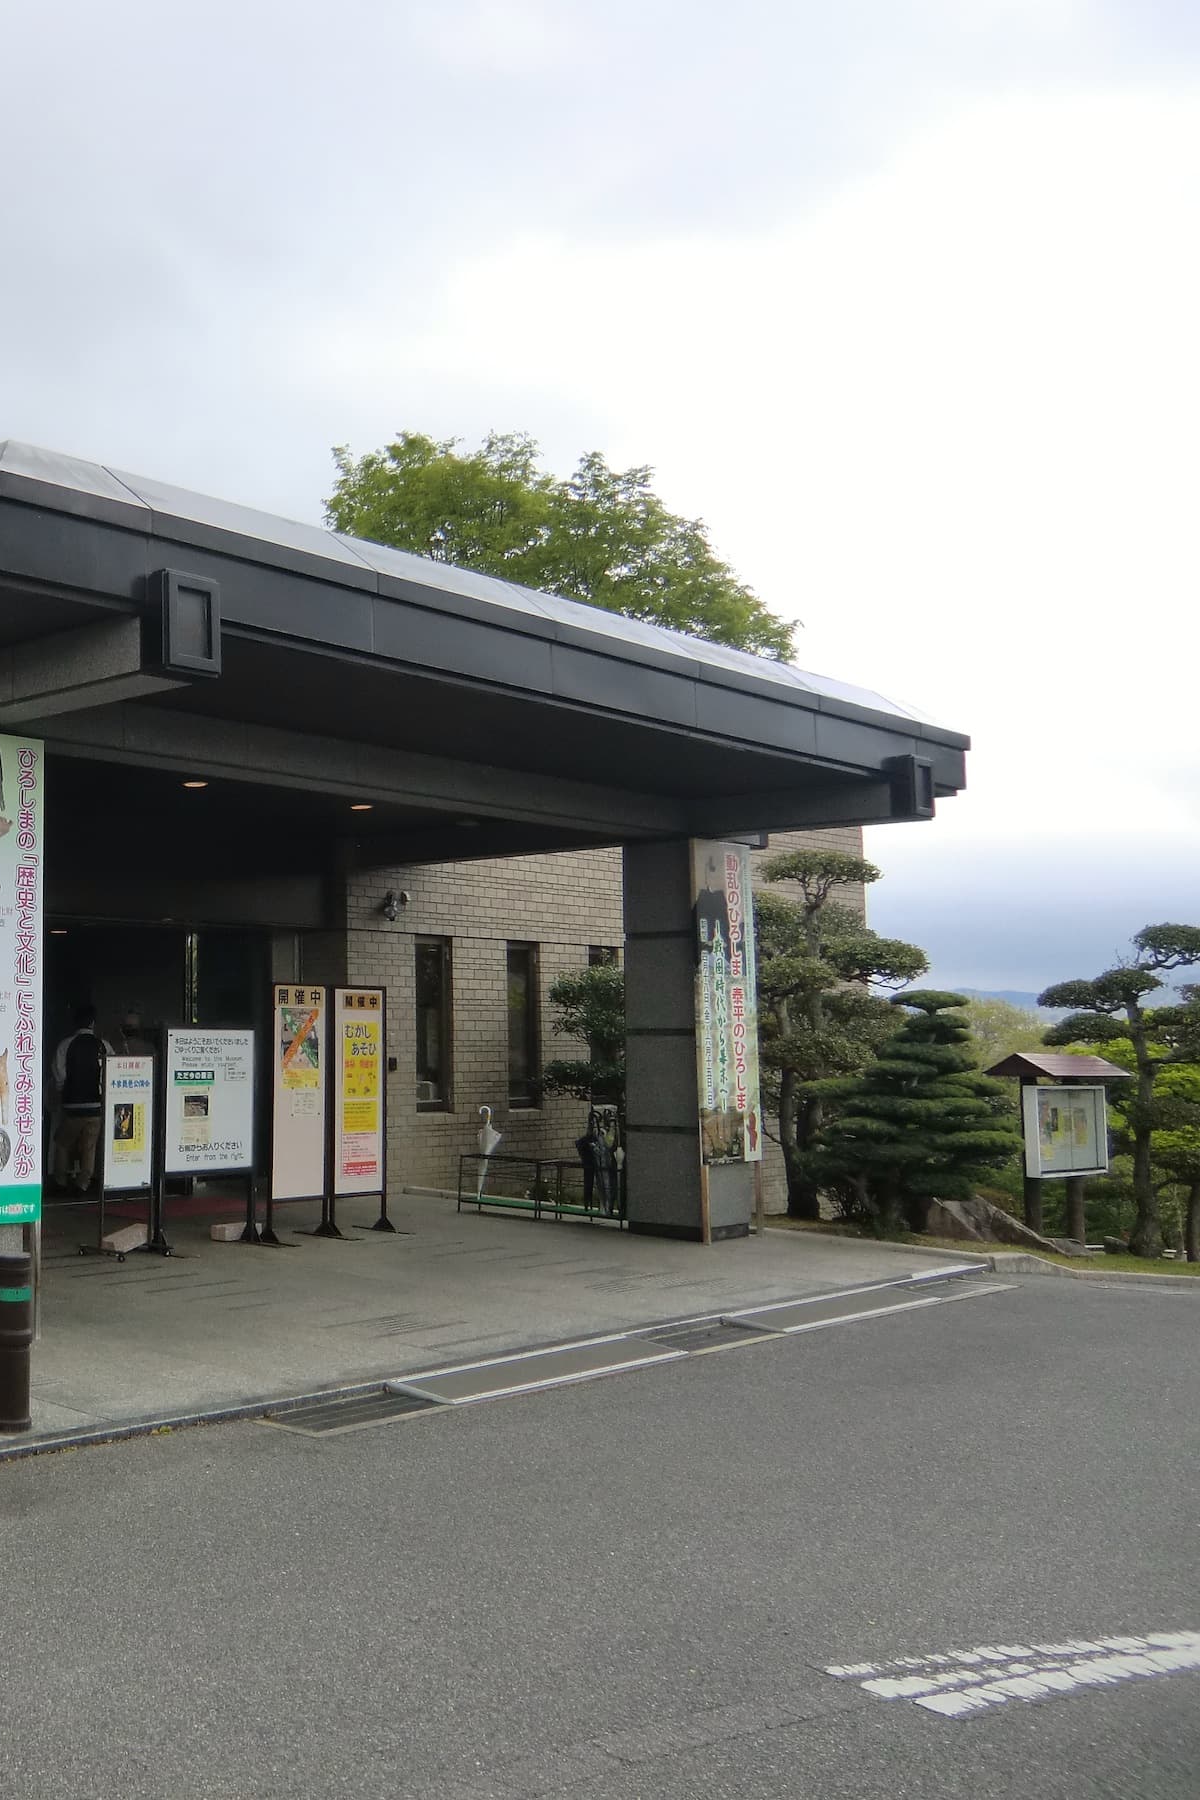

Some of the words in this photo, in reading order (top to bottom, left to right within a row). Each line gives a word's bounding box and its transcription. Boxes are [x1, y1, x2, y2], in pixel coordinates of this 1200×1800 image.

[14, 748, 38, 1178] ひろしまの「歴史と文化」にふれてみませんか
[279, 989, 320, 1005] 開催中
[345, 1025, 371, 1038] むかし
